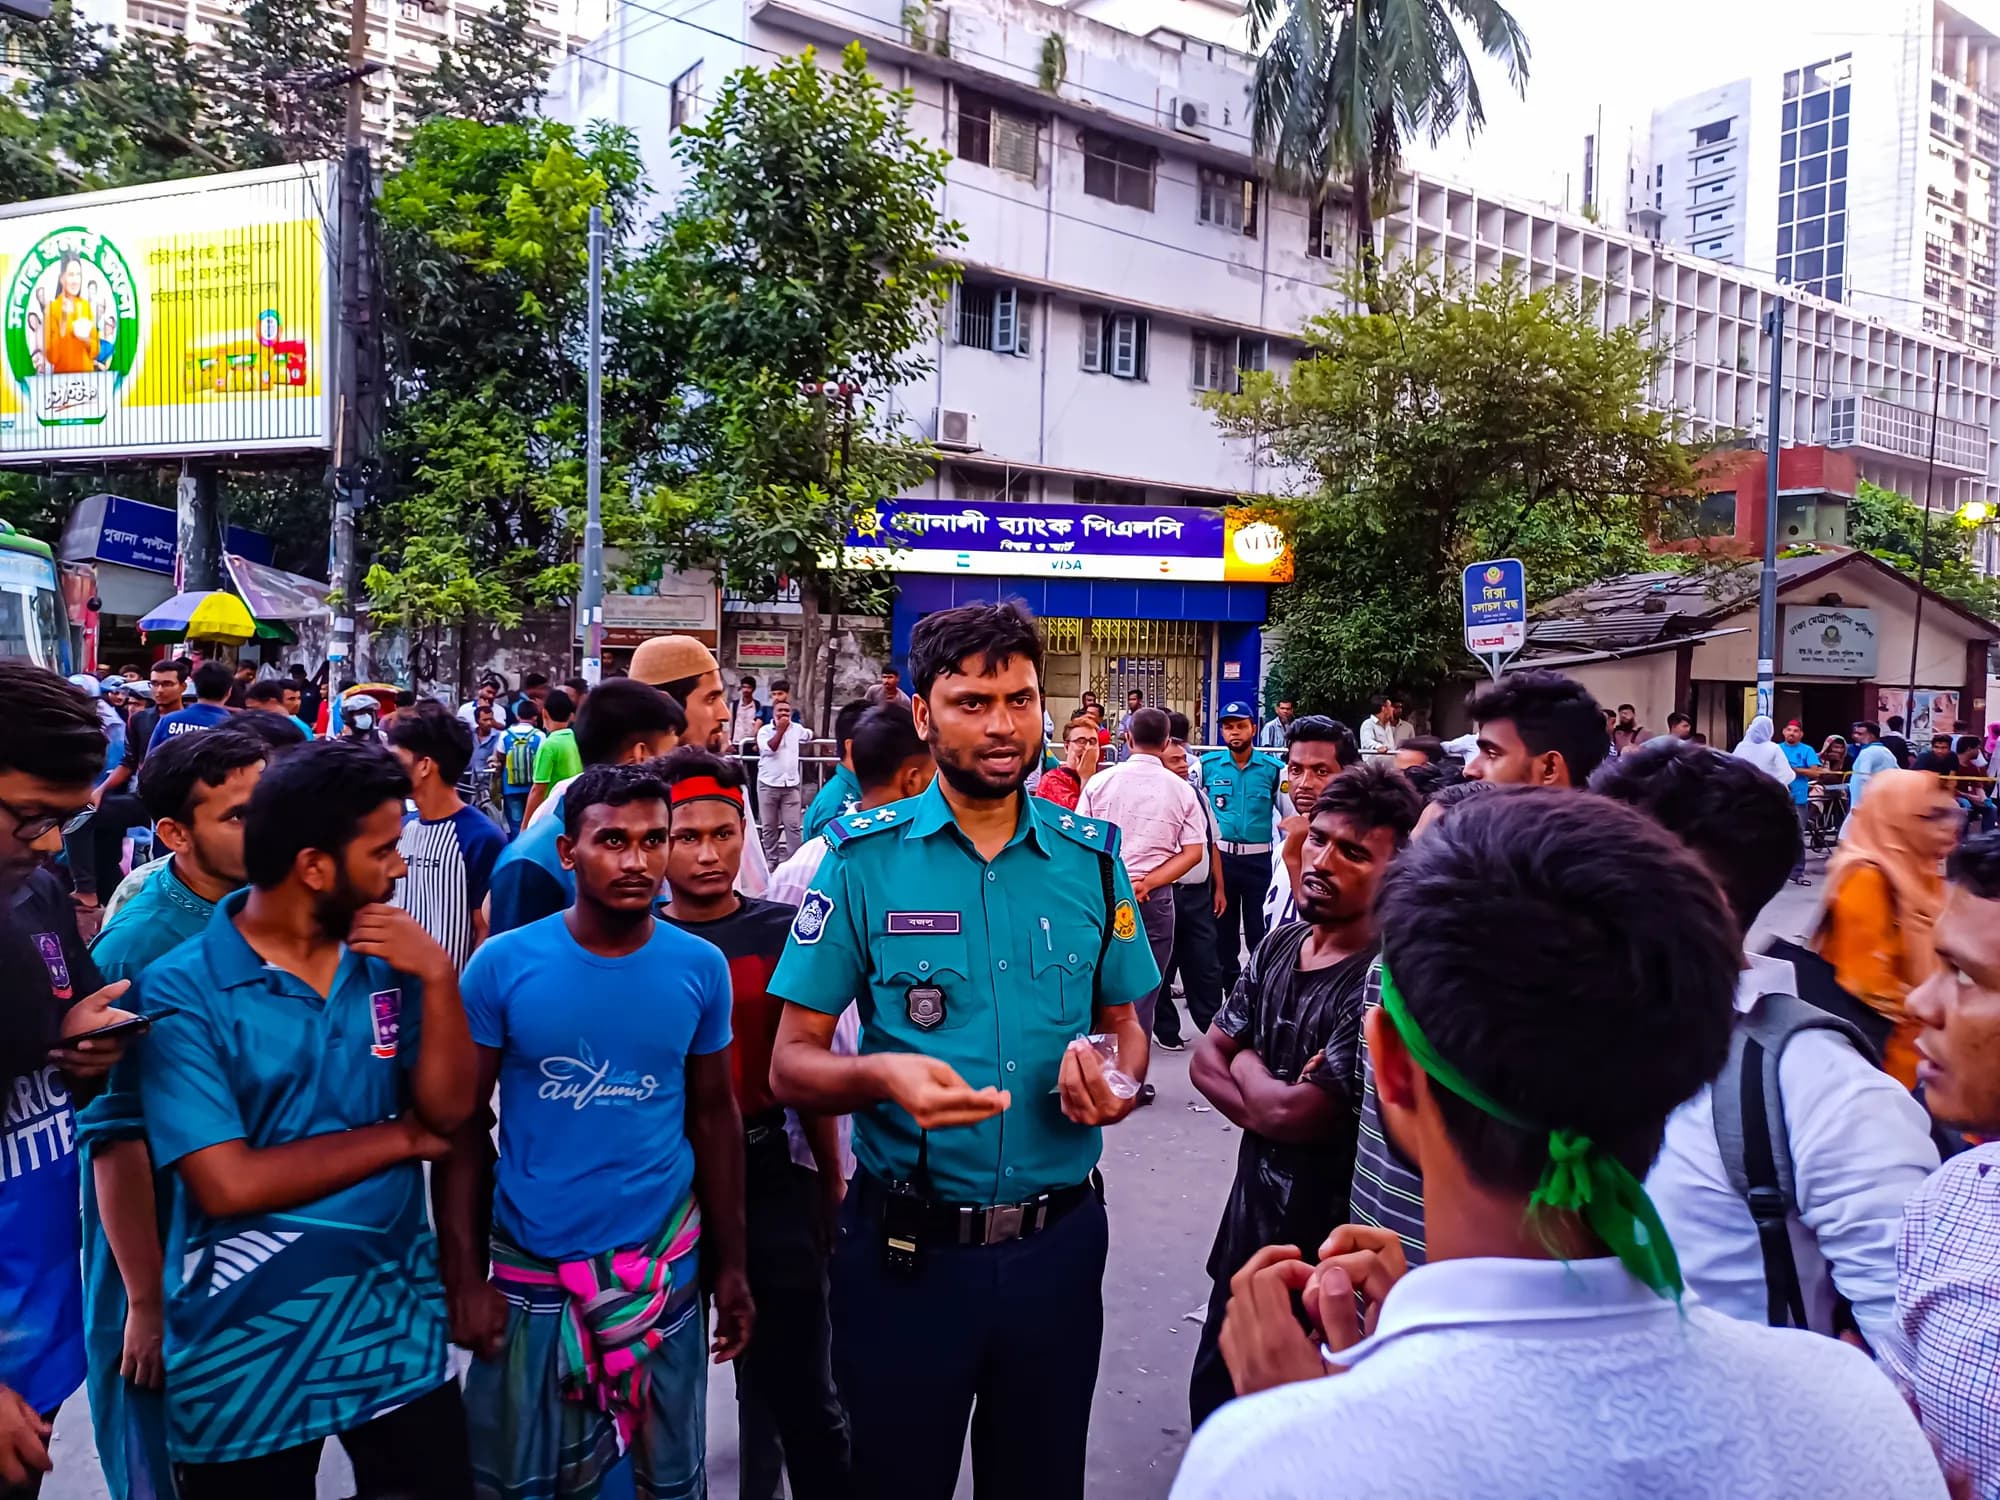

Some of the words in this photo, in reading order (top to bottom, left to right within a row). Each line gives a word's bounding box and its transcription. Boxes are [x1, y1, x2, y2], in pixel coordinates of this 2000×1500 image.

[996, 517, 1074, 537] ব্যাংক
[1081, 514, 1184, 540] পিএলসি
[104, 529, 139, 546] পুরানা
[1051, 560, 1082, 570] VISA
